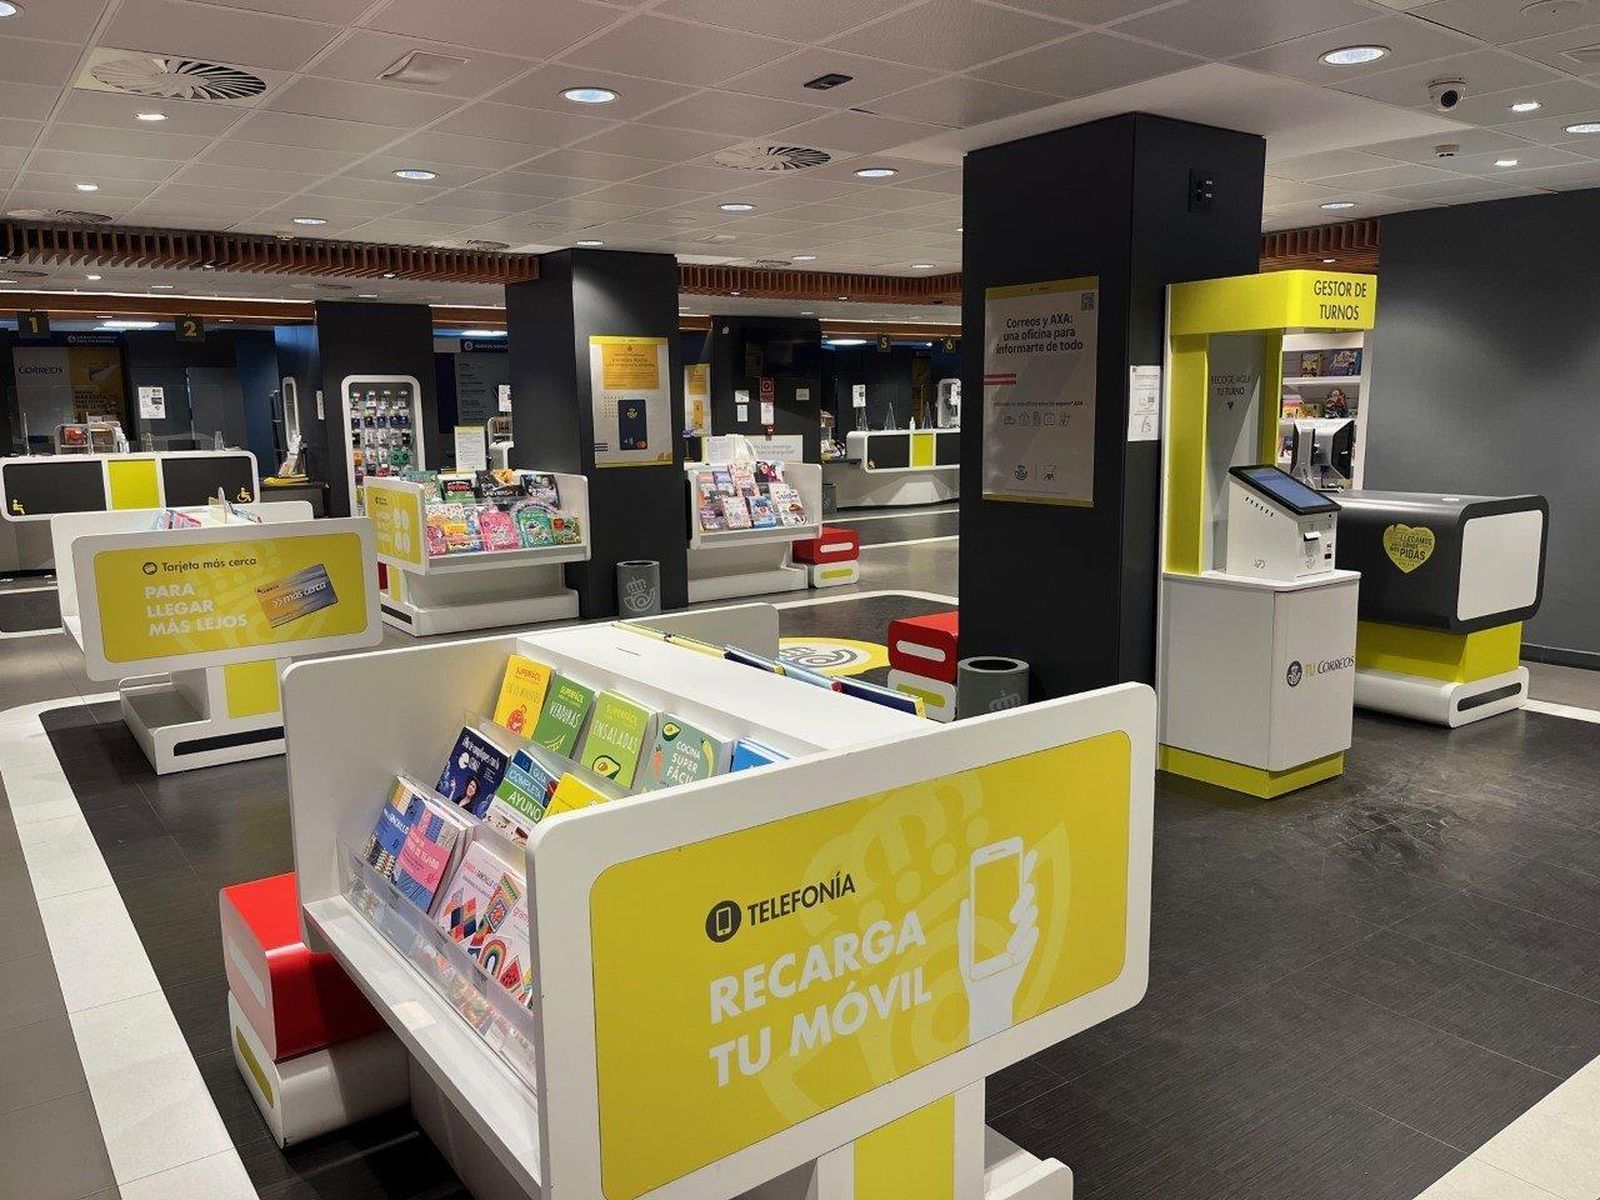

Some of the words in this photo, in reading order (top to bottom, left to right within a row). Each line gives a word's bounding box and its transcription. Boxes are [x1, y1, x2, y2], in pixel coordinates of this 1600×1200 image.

[1313, 279, 1352, 297] GESTOR
[1354, 282, 1367, 298] DE
[1006, 318, 1040, 329] Correos
[1042, 318, 1049, 328] y
[1050, 313, 1073, 325] AXA:
[1319, 304, 1360, 321] TURNOS
[28, 316, 38, 334] 1
[183, 320, 197, 337] 2
[1003, 332, 1020, 341] una
[1021, 328, 1052, 340] oficina
[1053, 327, 1076, 341] para
[945, 340, 954, 350] 6
[995, 342, 1043, 355] informarte
[1045, 339, 1058, 352] de
[1059, 338, 1084, 351] todo
[18, 364, 63, 375] CORREOS
[162, 560, 200, 574] Tarjeta
[203, 557, 226, 570] más
[228, 556, 257, 567] cerca
[144, 582, 195, 599] PARA
[303, 581, 327, 596] cerca
[146, 599, 214, 618] LLEGAR
[149, 617, 191, 637] MÁS
[196, 613, 249, 633] LEJOS
[1305, 662, 1317, 677] TU
[1317, 655, 1355, 675] CORREOS
[549, 700, 581, 729] VERDURAS
[592, 720, 640, 754] ENSALADAS
[675, 740, 701, 760] COCINA
[671, 753, 698, 774] SUPER
[507, 790, 542, 822] AYUNO
[747, 871, 856, 926] TELEFONÍA
[709, 910, 928, 1025] RECARGA
[708, 1026, 772, 1088] TU
[788, 965, 933, 1058] MÓVIL
